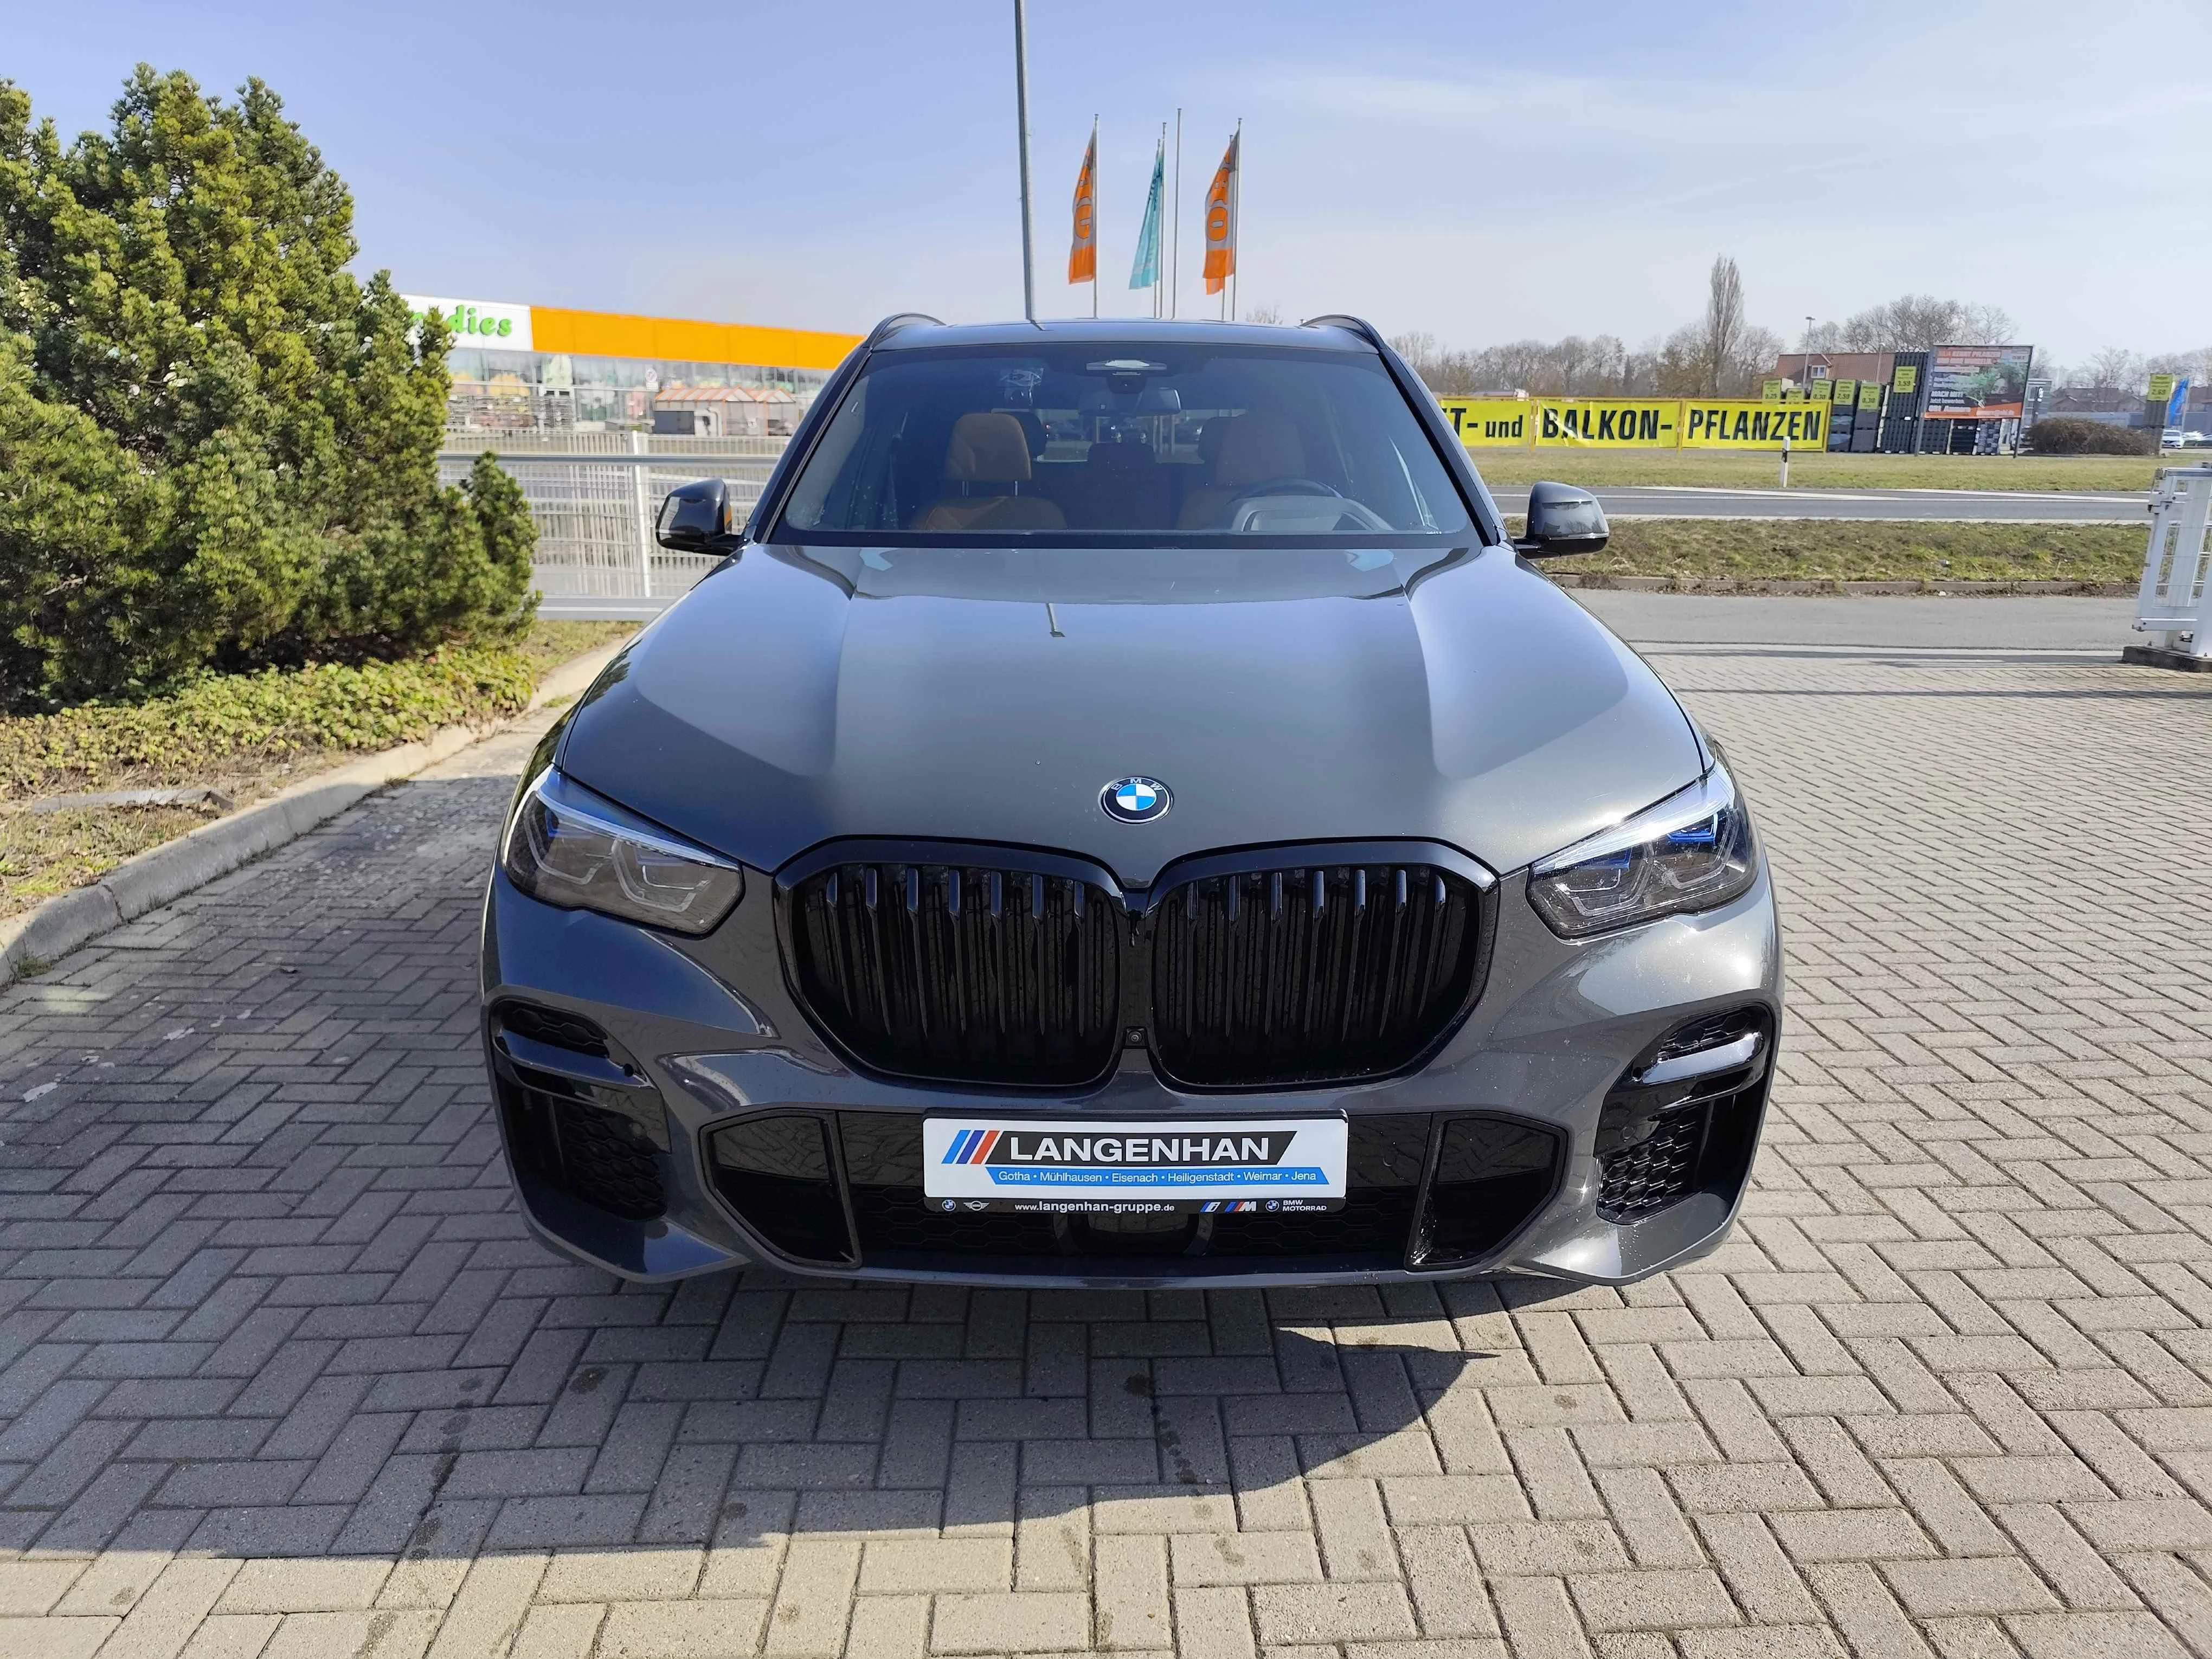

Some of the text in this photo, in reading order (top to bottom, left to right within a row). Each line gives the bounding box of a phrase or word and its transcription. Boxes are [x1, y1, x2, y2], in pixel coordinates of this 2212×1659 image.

[1442, 408, 1821, 440] T- und BALKON- PFLANZEN
[1111, 779, 1163, 790] BMW
[1011, 1137, 1269, 1162] LANGENHAN
[999, 1171, 1316, 1184] Gotha Mühlhausen Eisenach Heiligenstadt Weimar Jena
[1015, 1201, 1175, 1214] www.langenhan-gruppe.de
